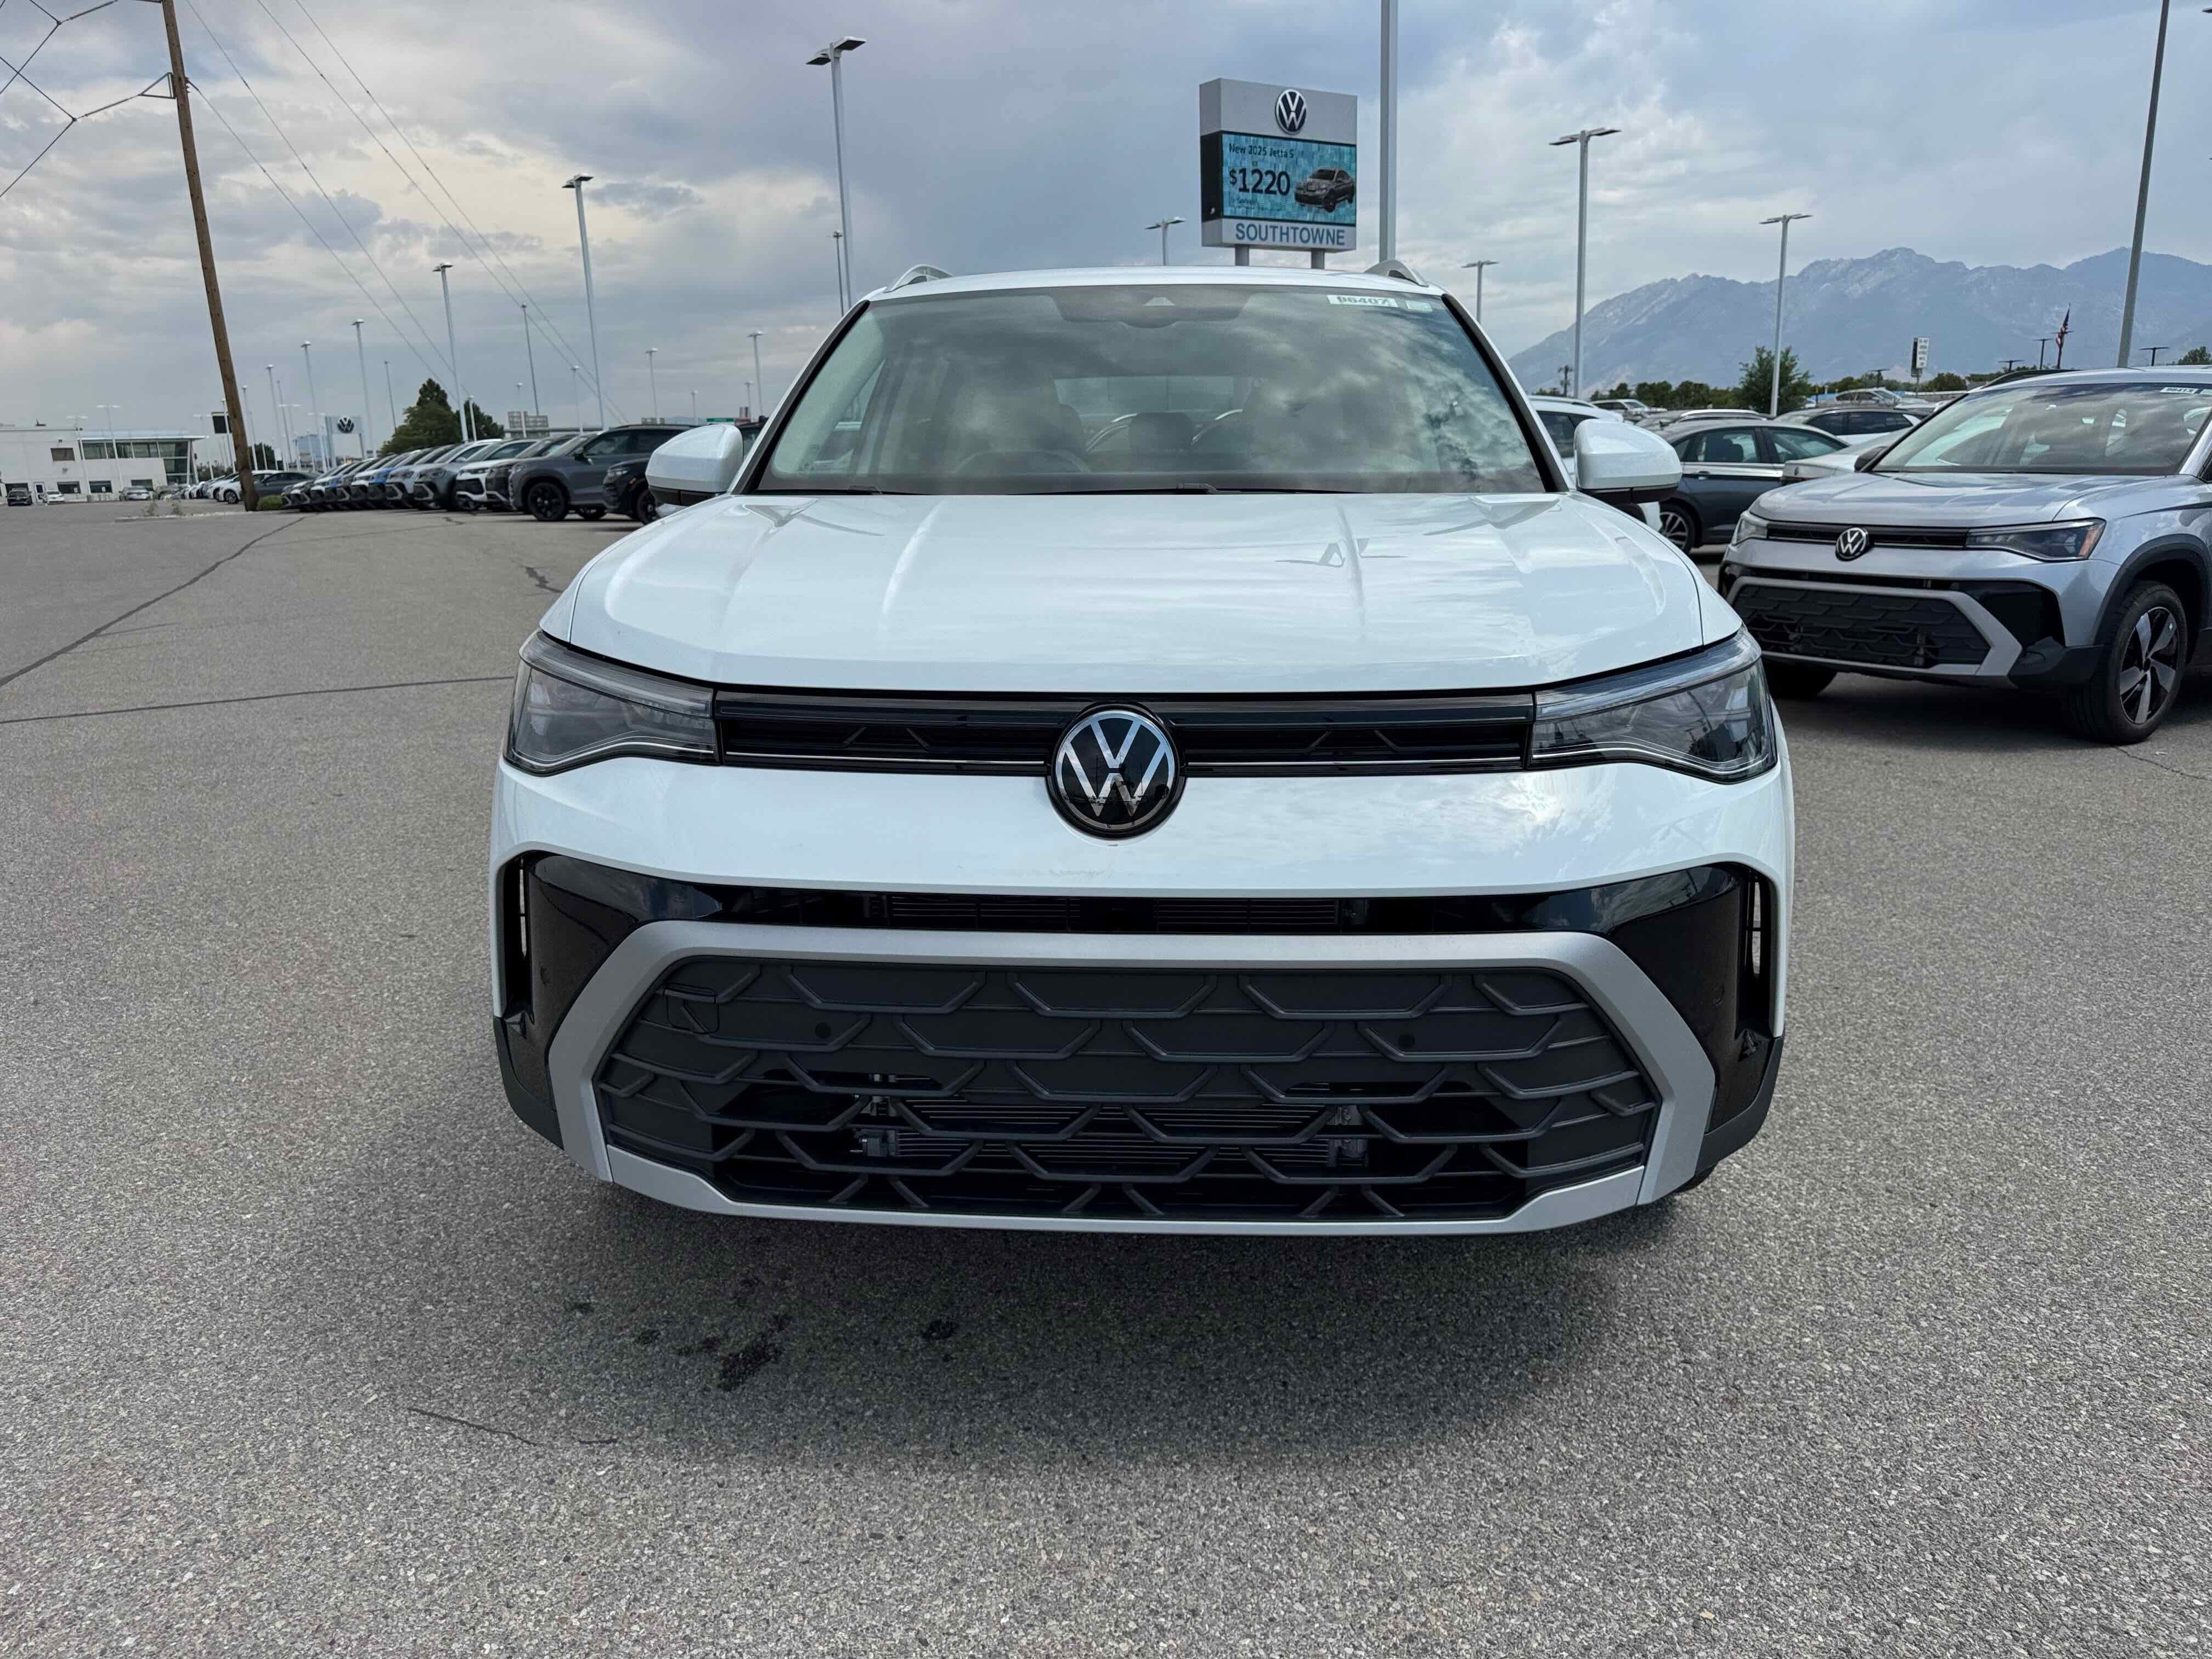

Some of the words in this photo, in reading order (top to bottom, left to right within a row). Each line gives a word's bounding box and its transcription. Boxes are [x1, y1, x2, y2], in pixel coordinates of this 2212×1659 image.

[1229, 143, 1246, 154] New
[1248, 145, 1267, 156] 2025
[1269, 148, 1288, 159] Jetta
[1229, 167, 1290, 196] $1220
[1235, 223, 1345, 245] SOUTHTOWNE
